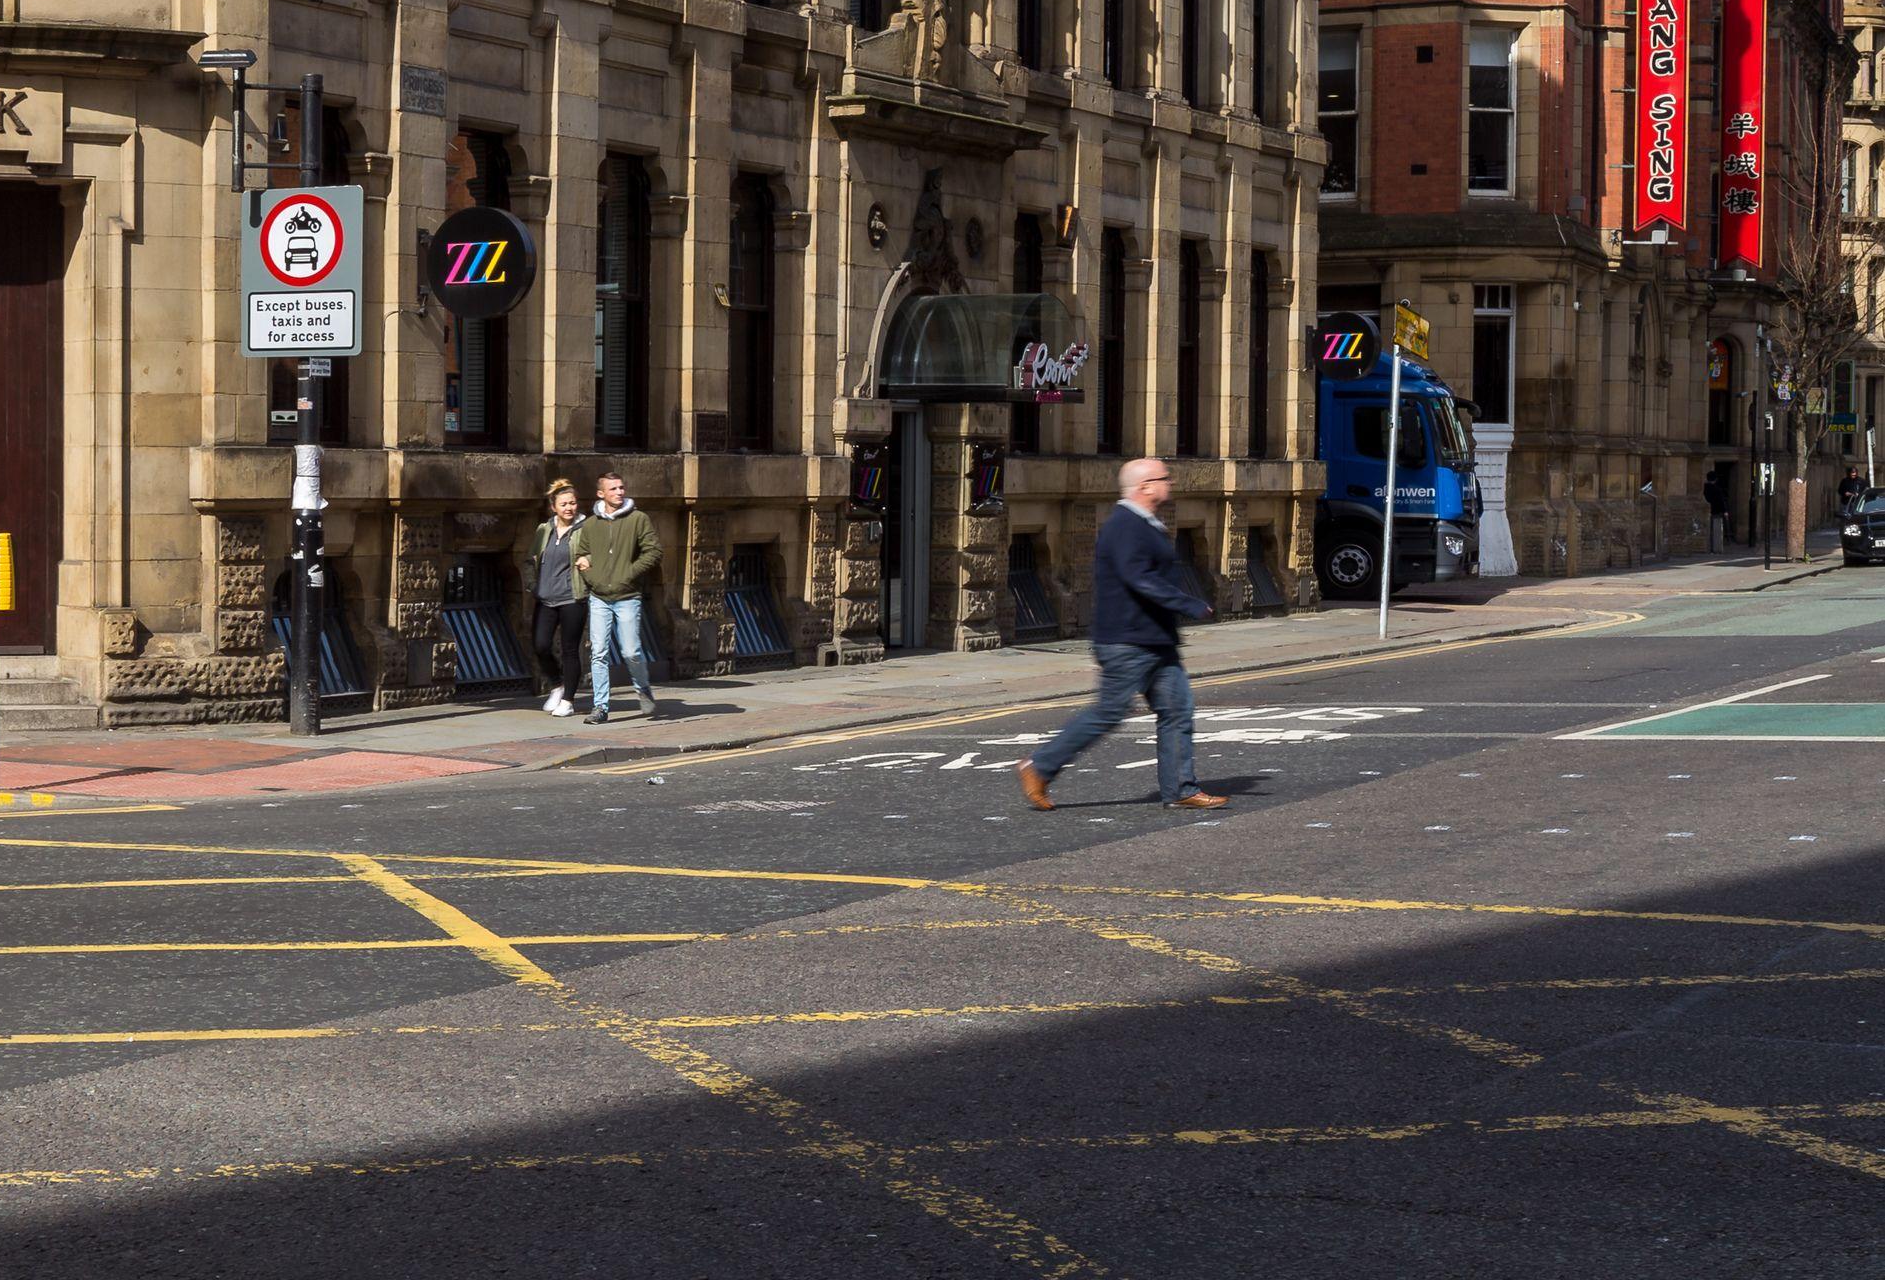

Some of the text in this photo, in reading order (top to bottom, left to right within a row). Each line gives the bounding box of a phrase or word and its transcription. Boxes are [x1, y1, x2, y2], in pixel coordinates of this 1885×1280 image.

[1647, 93, 1676, 203] SING
[1723, 112, 1759, 215] 羊城樓
[256, 299, 301, 313] Except
[272, 314, 331, 327] taxis and
[268, 331, 335, 342] for access
[1375, 484, 1436, 497] afnwen
